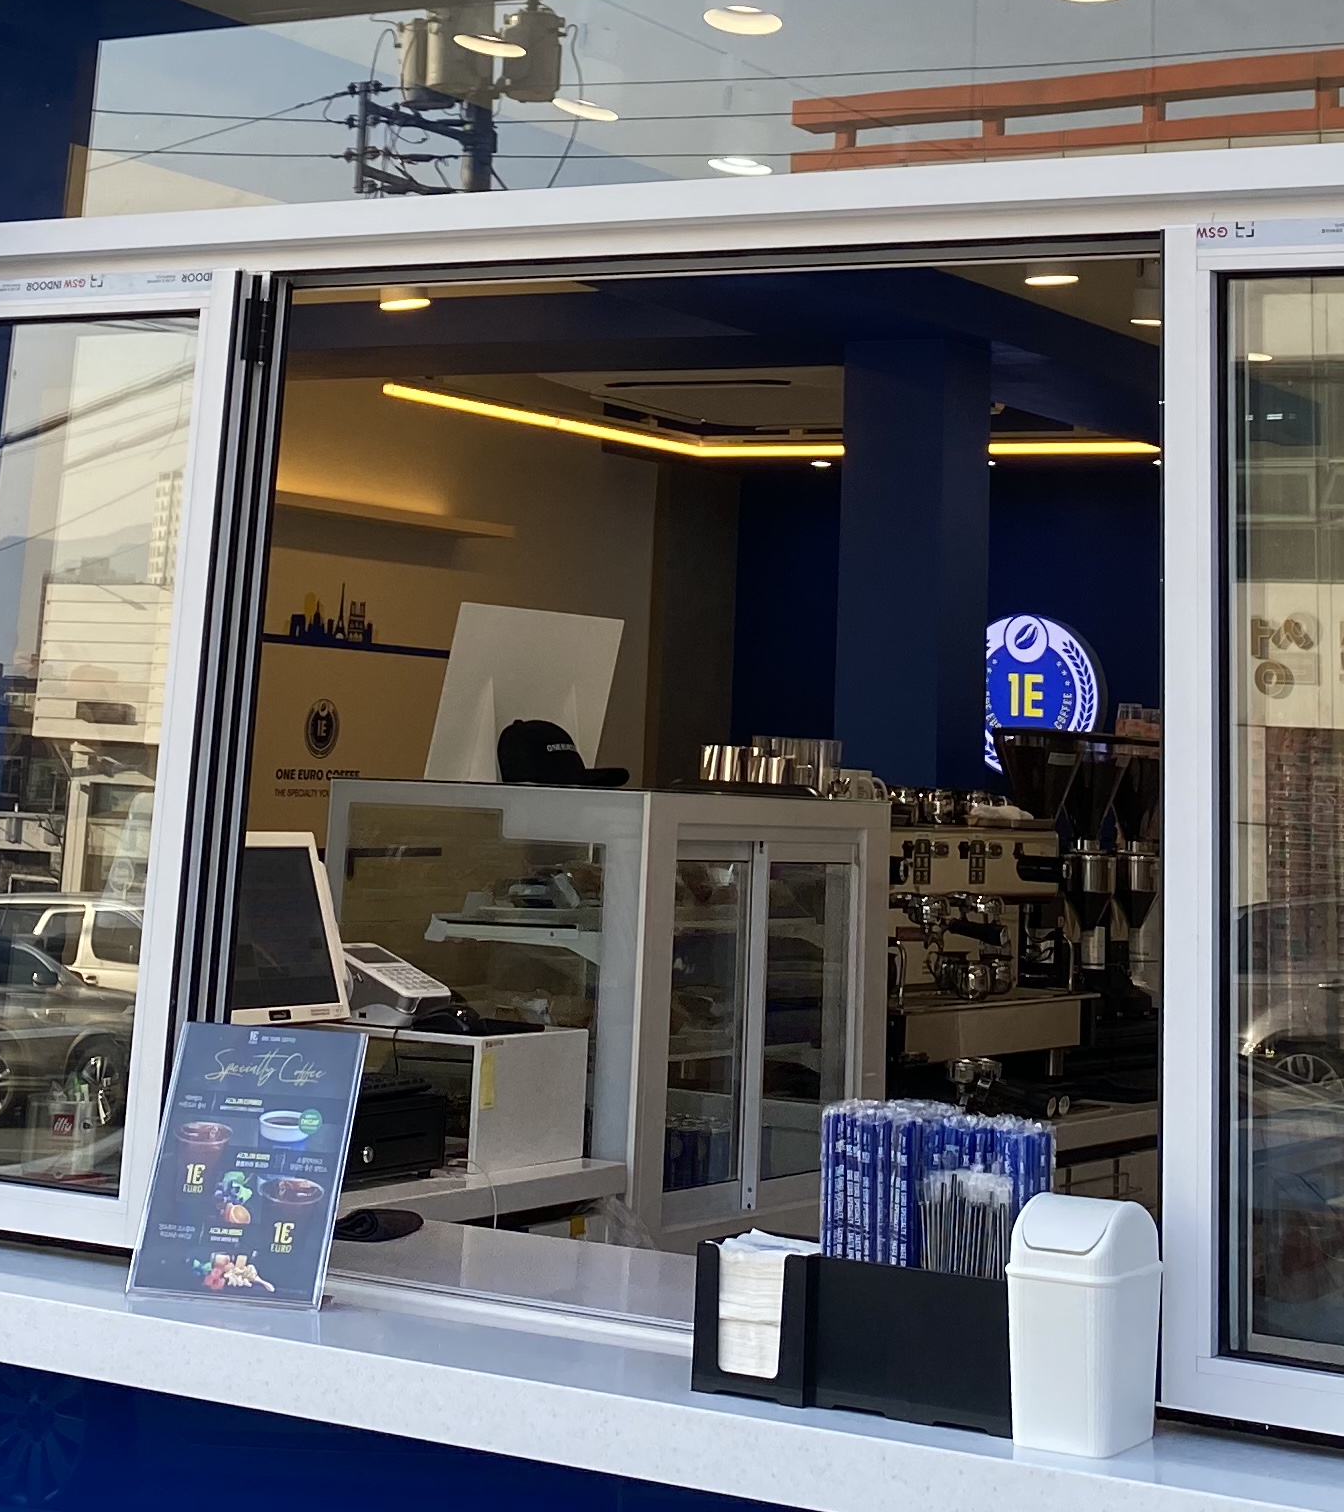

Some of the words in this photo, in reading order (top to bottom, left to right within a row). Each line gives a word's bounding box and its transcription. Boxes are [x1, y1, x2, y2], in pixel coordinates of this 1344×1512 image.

[1008, 673, 1044, 718] 1E
[275, 768, 297, 780] ONE
[297, 769, 324, 781] EURO
[205, 1048, 288, 1087] Specialty
[278, 1052, 327, 1087] Coffee
[54, 1117, 73, 1134] illy
[270, 1244, 293, 1254] EURO
